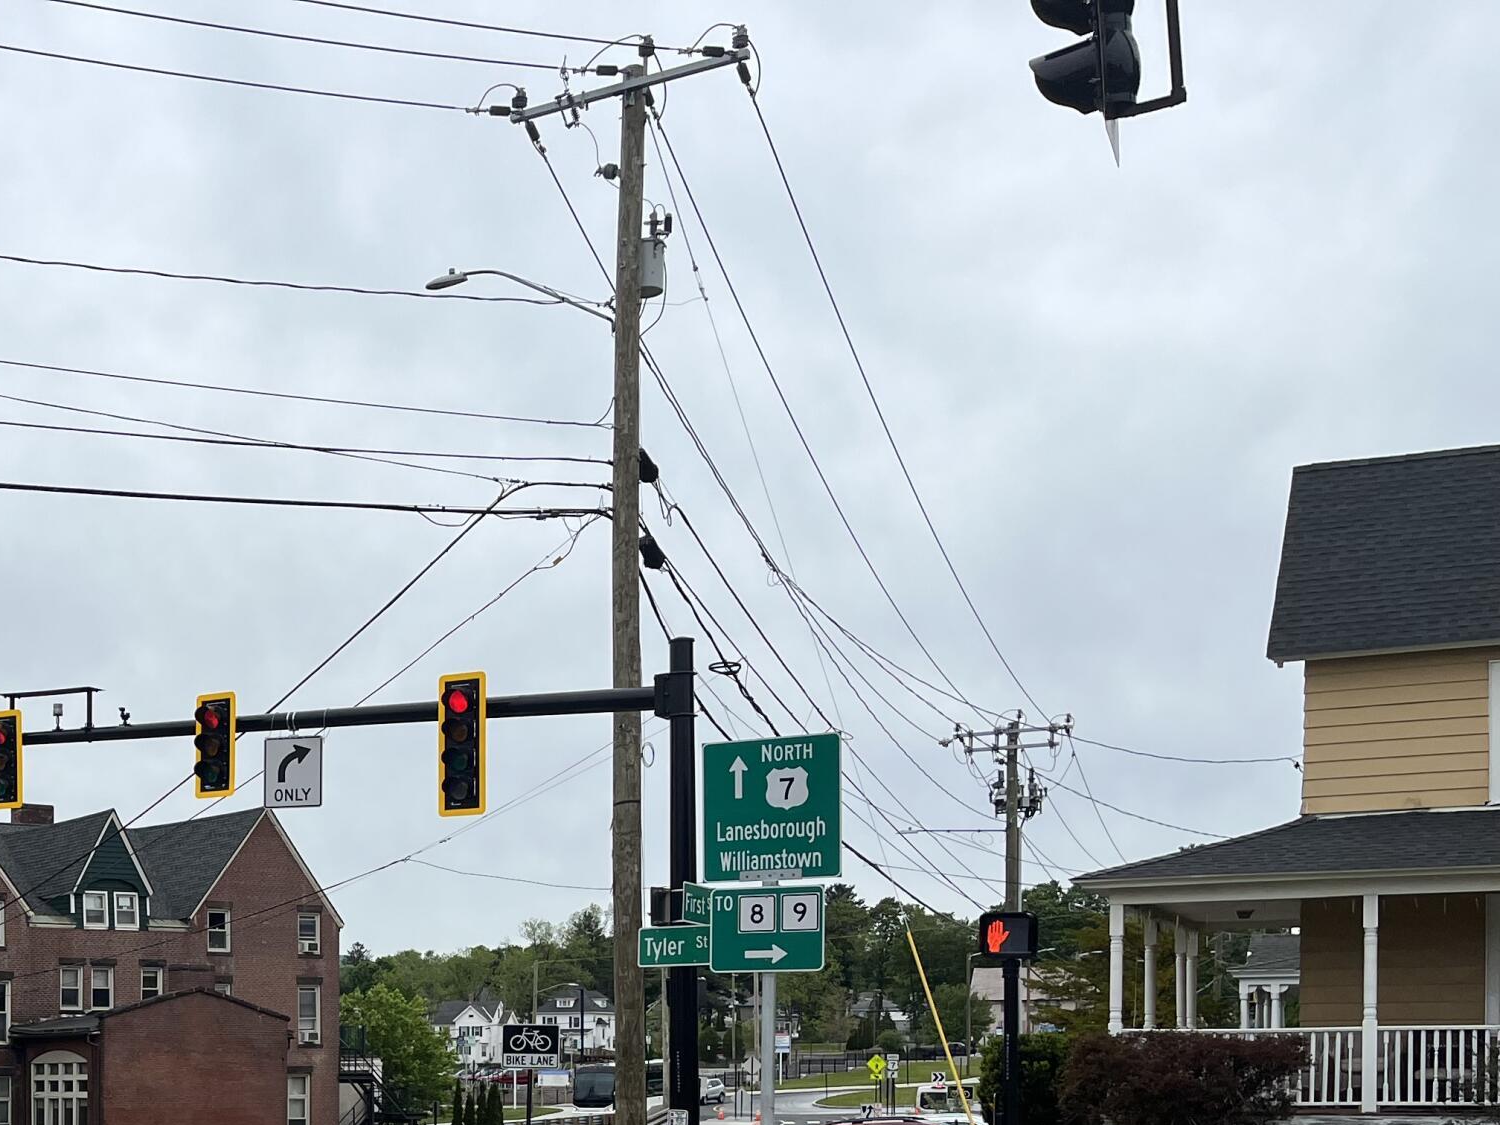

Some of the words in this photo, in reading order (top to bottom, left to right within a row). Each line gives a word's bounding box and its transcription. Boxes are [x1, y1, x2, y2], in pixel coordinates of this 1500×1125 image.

[761, 743, 813, 762] NORTH
[274, 788, 311, 802] ONLY
[779, 777, 795, 800] 7
[716, 816, 826, 843] Lanesborough
[720, 849, 822, 872] Williamstown
[685, 892, 705, 915] First
[715, 895, 733, 912] TO
[750, 903, 764, 924] 8
[793, 902, 807, 923] 9
[644, 937, 685, 963] Tyler
[695, 935, 708, 949] St
[506, 1055, 526, 1066] BIKE
[530, 1055, 554, 1066] LANE
